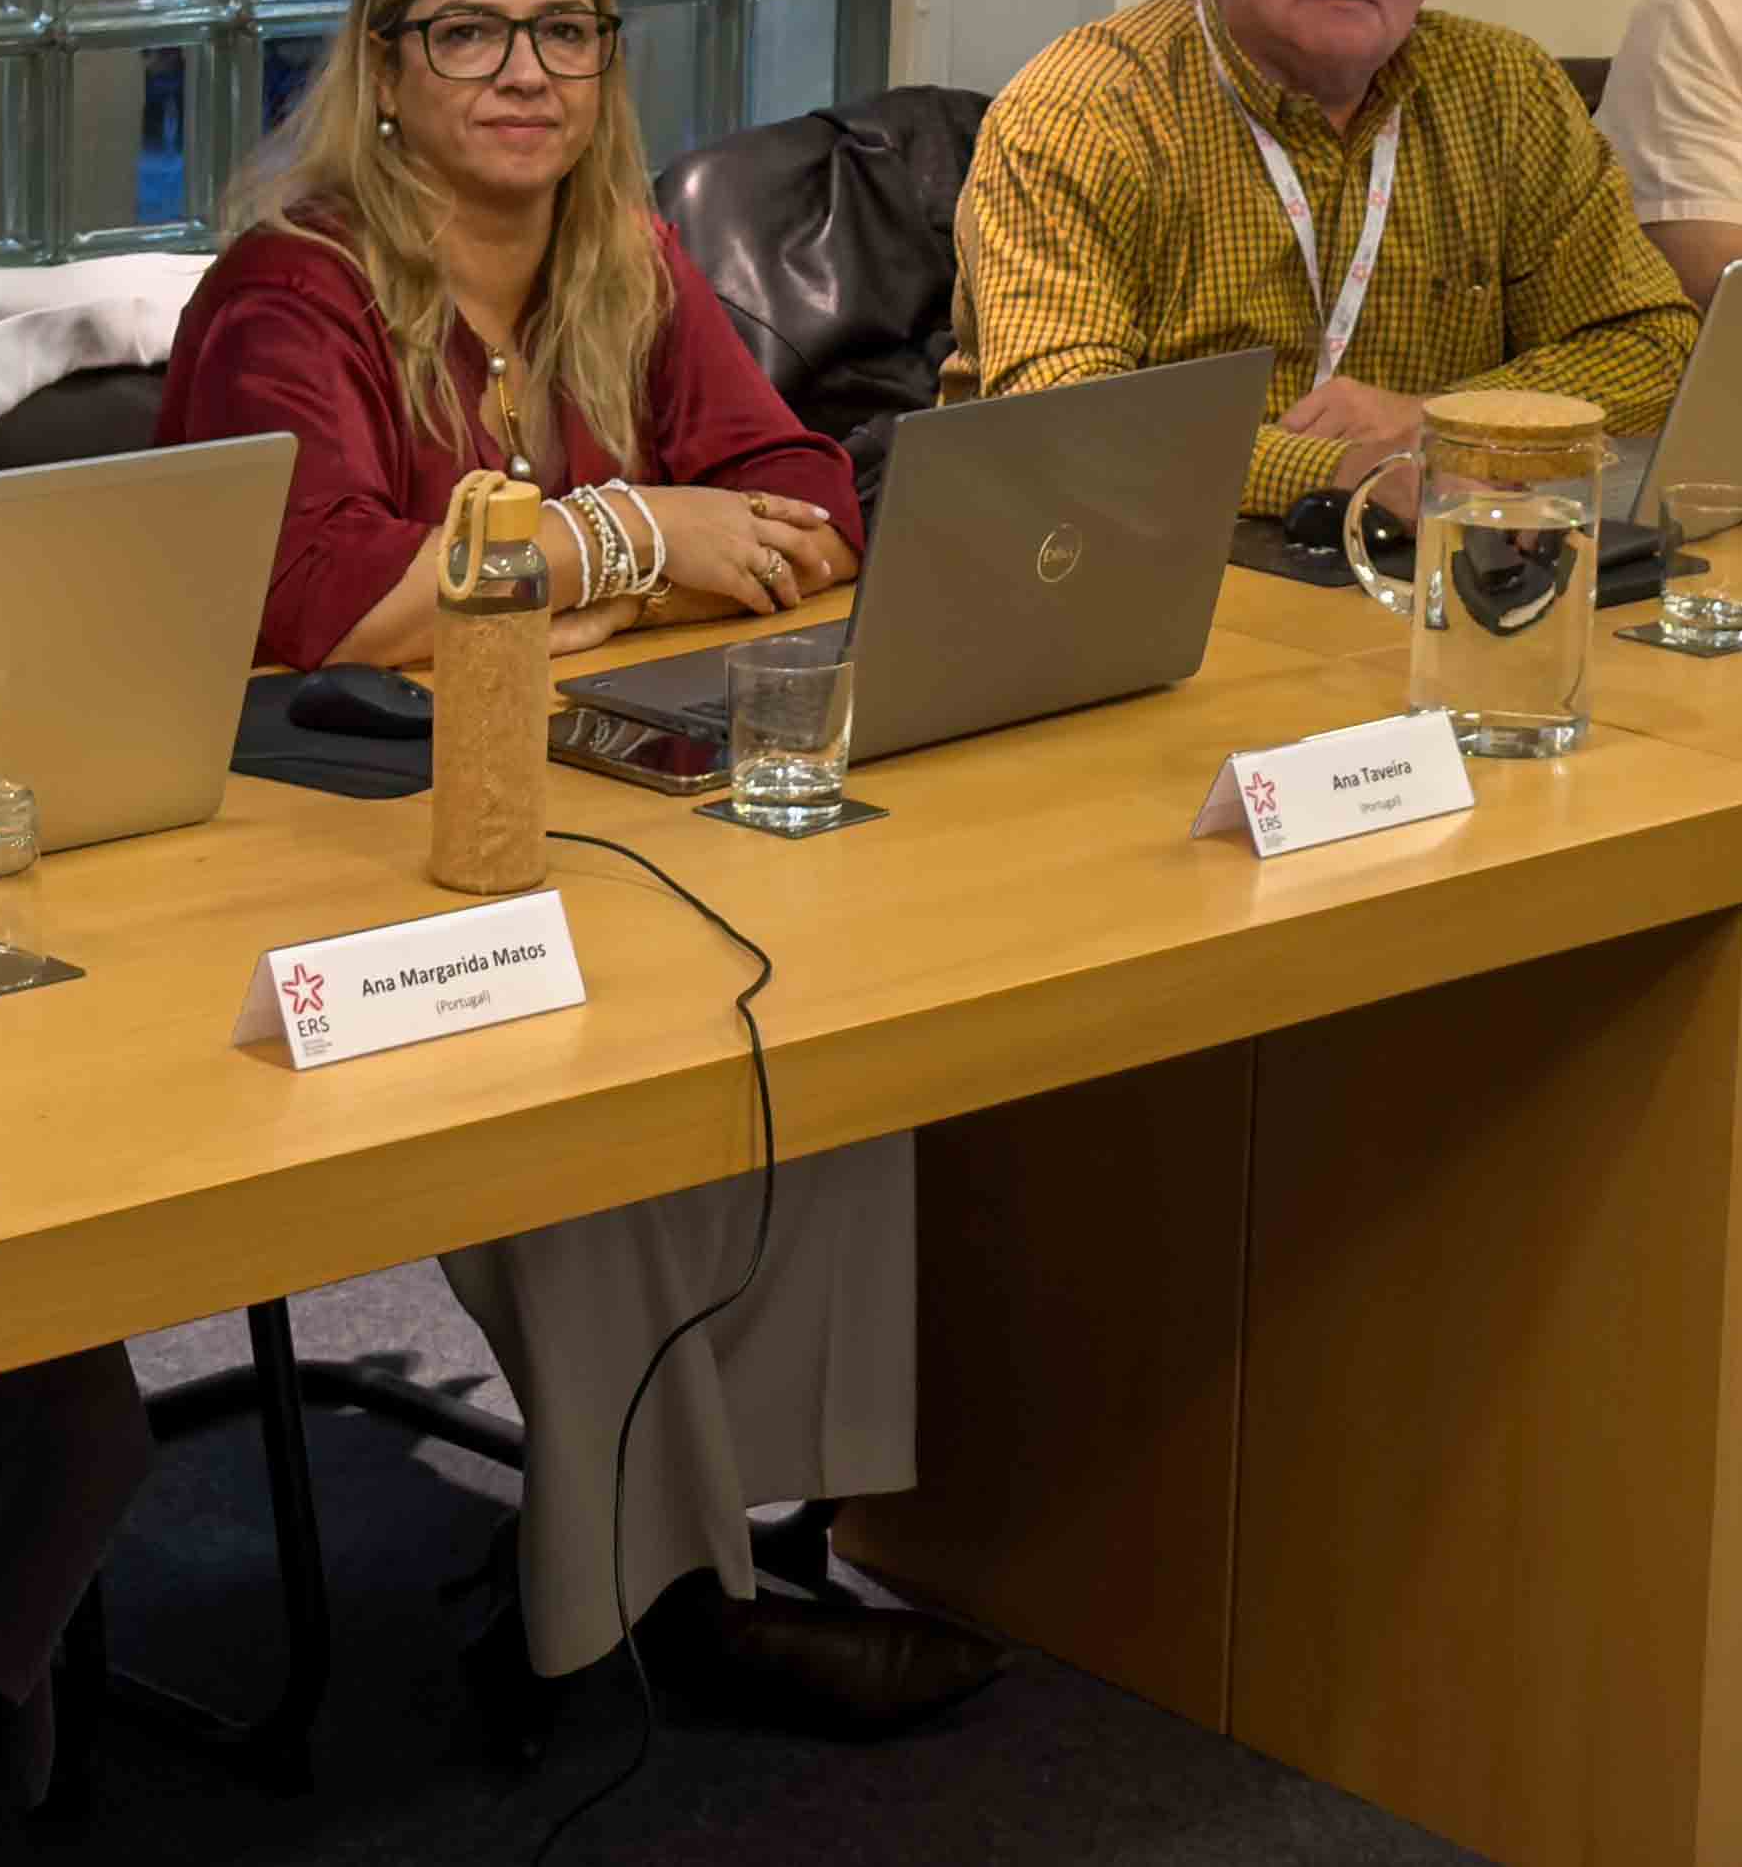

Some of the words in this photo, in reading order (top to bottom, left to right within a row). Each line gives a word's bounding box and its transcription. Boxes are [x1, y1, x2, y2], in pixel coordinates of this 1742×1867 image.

[1332, 773, 1360, 791] Ana
[1361, 759, 1412, 783] Taveira
[1258, 815, 1282, 833] ERS
[362, 977, 396, 997] Ana
[400, 954, 490, 988] Margarida
[492, 943, 547, 967] Matos
[436, 989, 491, 1015] (Portugal)
[297, 1015, 330, 1038] ERS
